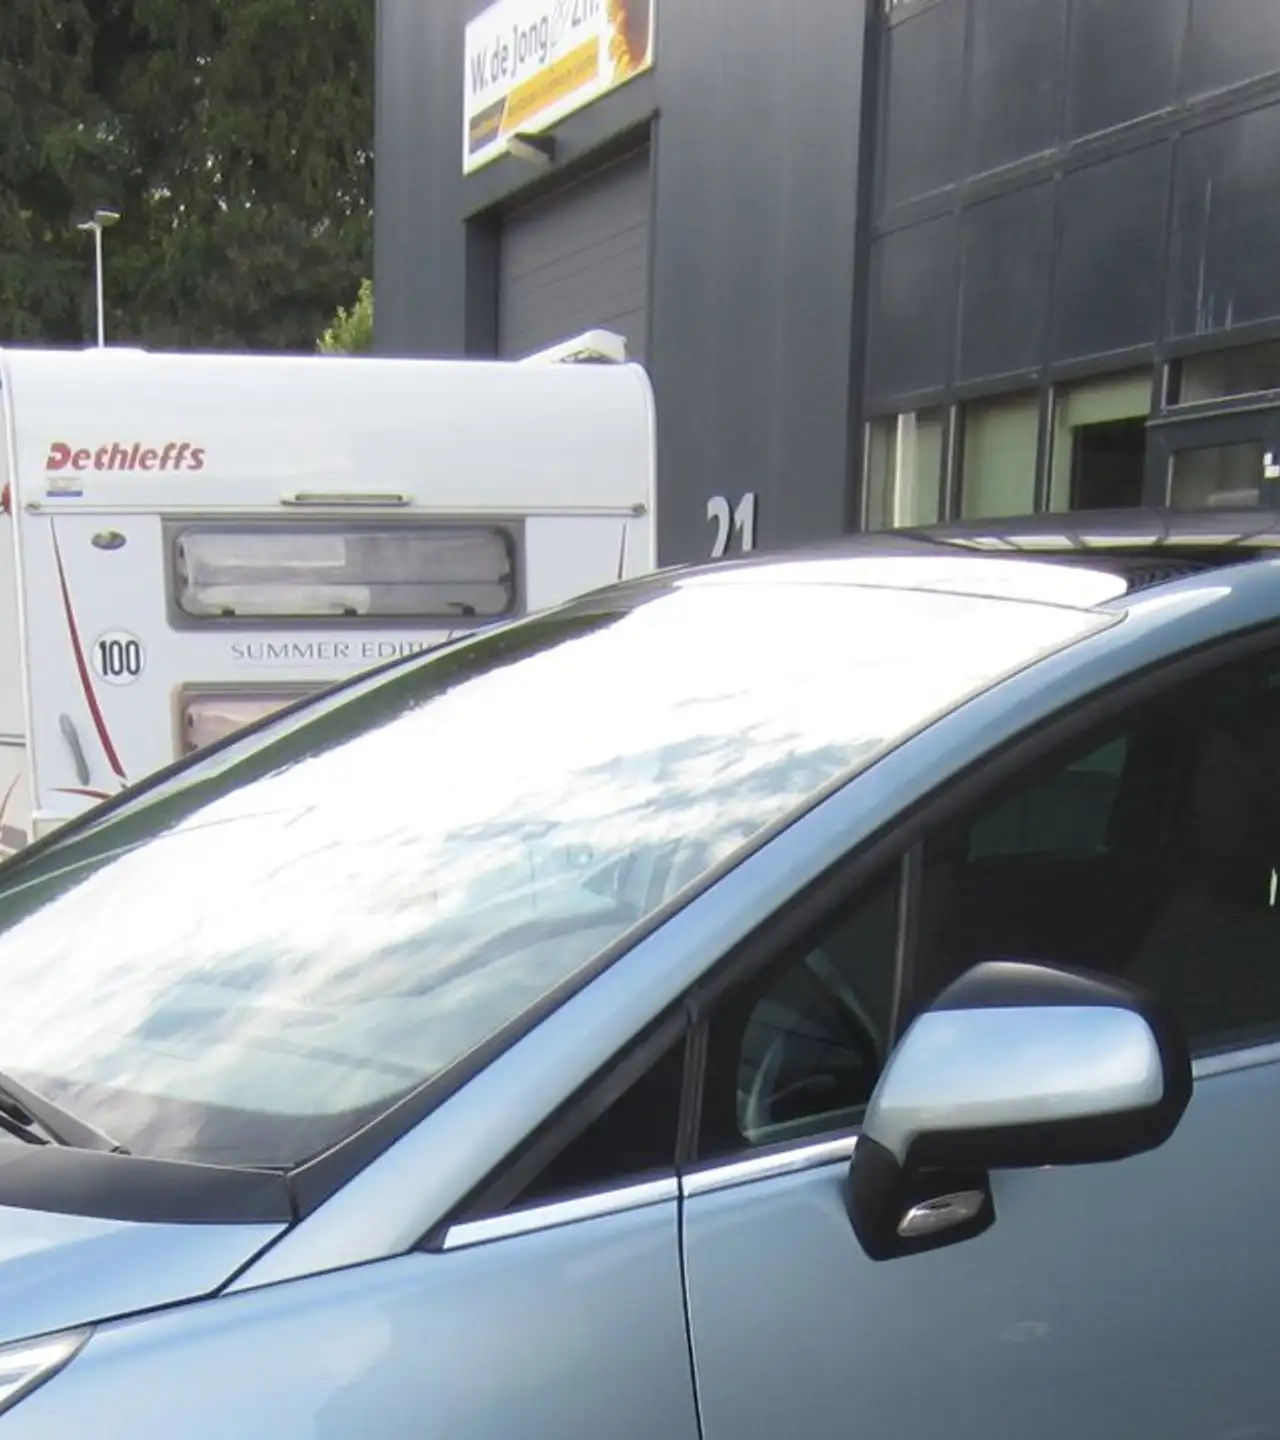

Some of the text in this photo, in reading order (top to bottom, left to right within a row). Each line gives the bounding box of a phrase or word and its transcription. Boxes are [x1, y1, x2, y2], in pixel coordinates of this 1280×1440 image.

[491, 35, 509, 84] de
[510, 16, 549, 79] Jong
[46, 442, 205, 471] Dethleffs
[706, 492, 755, 558] 21
[99, 640, 140, 676] 100
[230, 641, 350, 660] SUMMER
